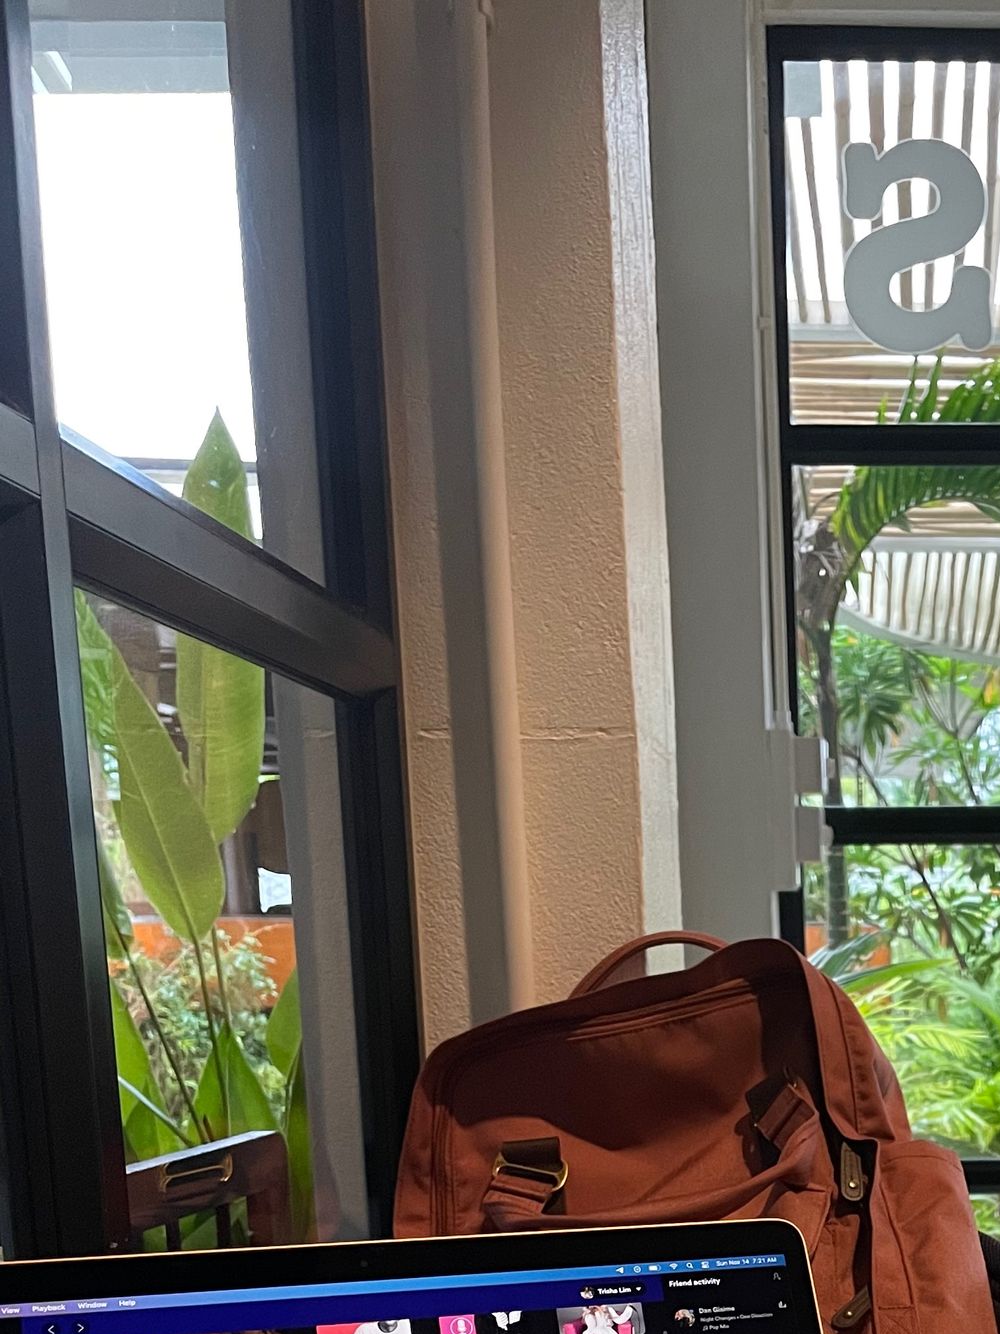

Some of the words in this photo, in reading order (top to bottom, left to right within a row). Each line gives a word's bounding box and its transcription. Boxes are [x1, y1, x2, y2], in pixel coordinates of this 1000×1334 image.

[766, 1256, 777, 1264] AM
[668, 1278, 692, 1288] Friend
[693, 1276, 721, 1288] activity
[597, 1286, 618, 1295] Trisha
[618, 1285, 632, 1294] Lim
[1, 1307, 20, 1315] View
[32, 1303, 66, 1314] Playback
[77, 1301, 108, 1310] Window
[118, 1299, 136, 1308] Help
